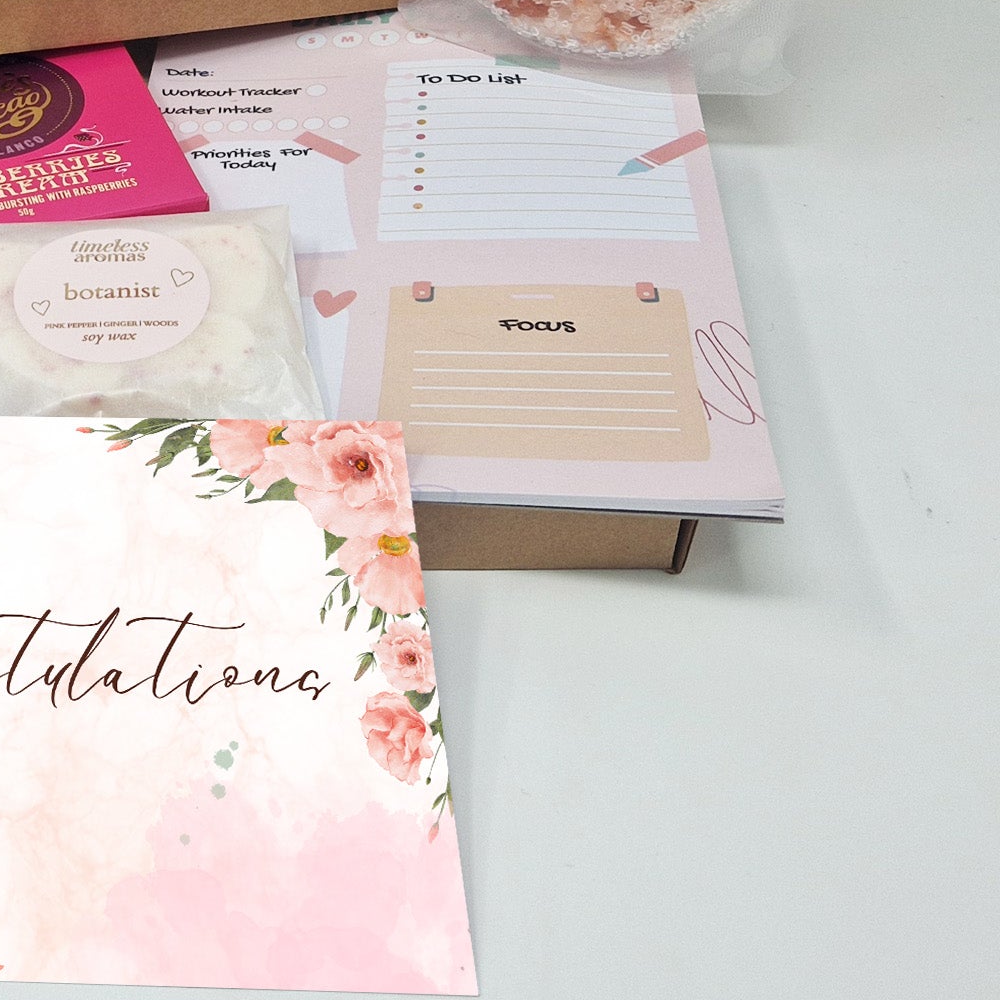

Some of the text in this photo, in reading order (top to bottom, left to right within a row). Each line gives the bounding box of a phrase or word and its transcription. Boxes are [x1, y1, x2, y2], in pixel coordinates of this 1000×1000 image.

[165, 68, 214, 77] Date:
[416, 73, 527, 84] To Do List
[162, 87, 302, 97] Workout Tracker
[219, 105, 273, 114] Intake
[191, 148, 312, 159] Priorities For
[220, 160, 276, 171] Today
[47, 190, 72, 203] WITH
[73, 178, 138, 197] RASPBERRIES
[18, 209, 35, 217] 50g
[70, 239, 150, 254] timeless
[73, 250, 146, 263] aromas
[64, 282, 161, 301] botanist
[44, 322, 66, 330] PINK
[499, 319, 576, 333] Focus
[82, 332, 137, 345] soy wax
